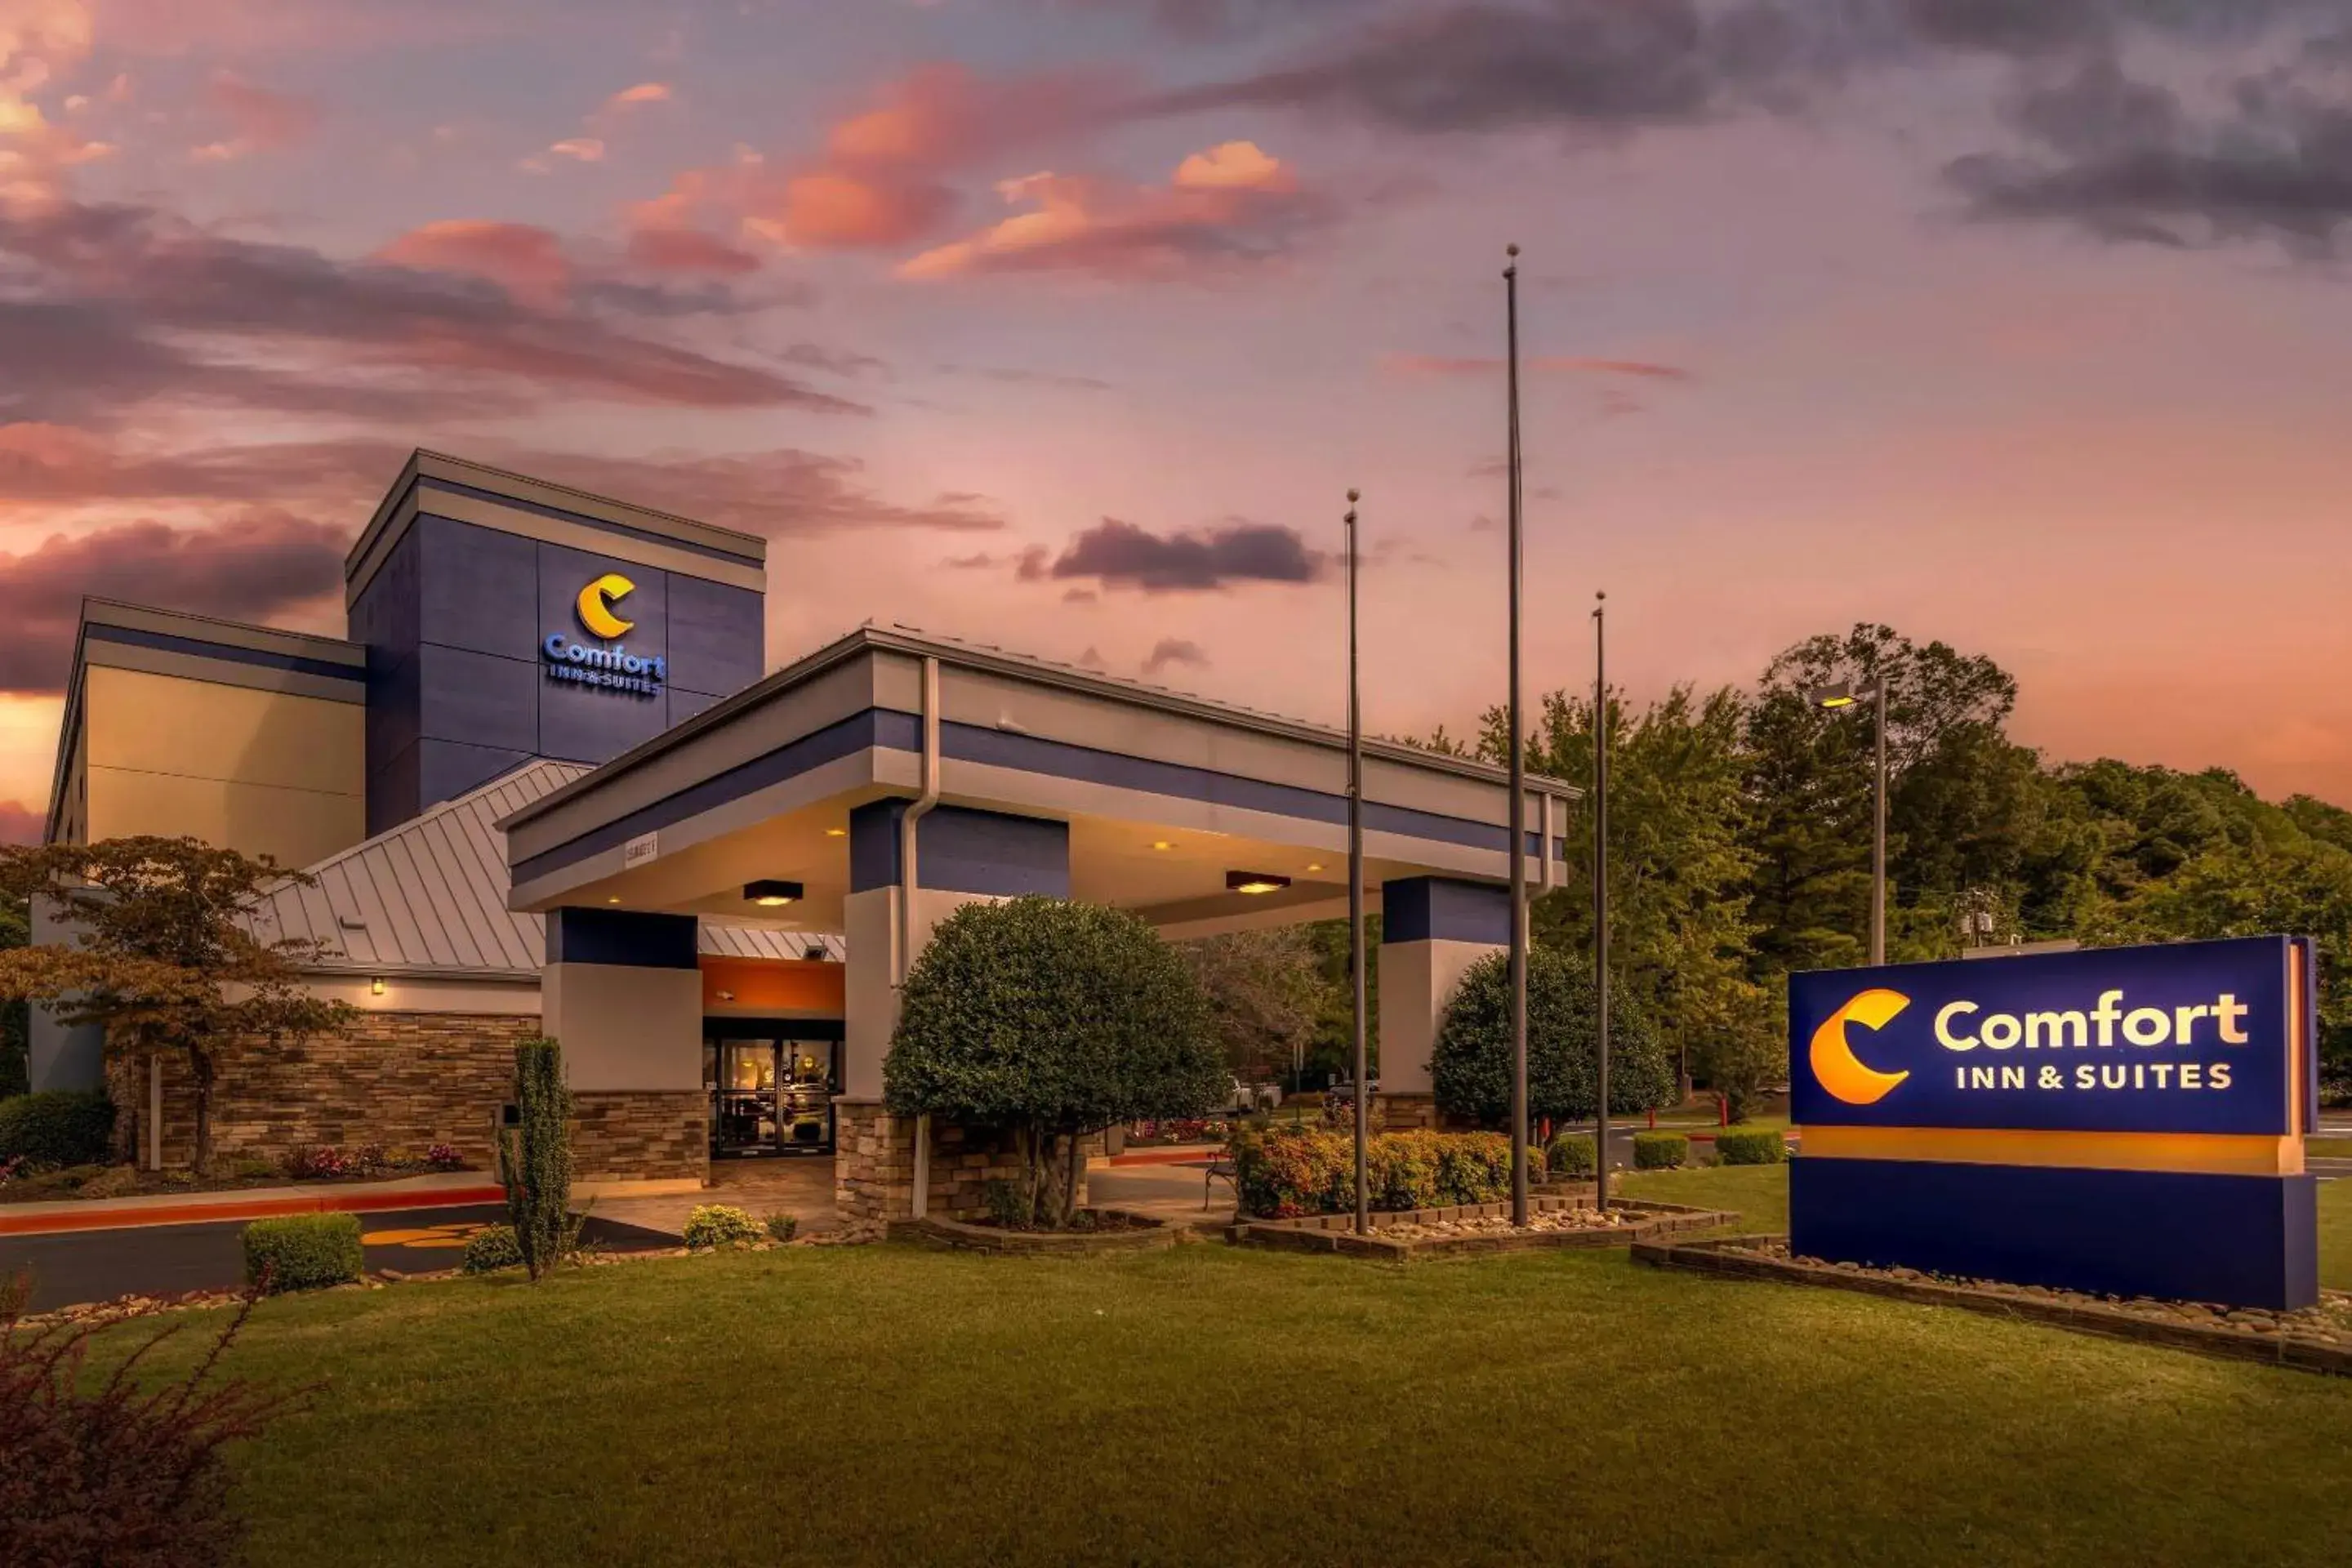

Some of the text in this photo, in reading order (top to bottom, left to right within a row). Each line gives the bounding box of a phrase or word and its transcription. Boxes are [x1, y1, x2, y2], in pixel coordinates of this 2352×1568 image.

[544, 632, 666, 678] Comfort
[1934, 989, 2248, 1052] Comfort
[1957, 1063, 2232, 1089] INN & SUITES
